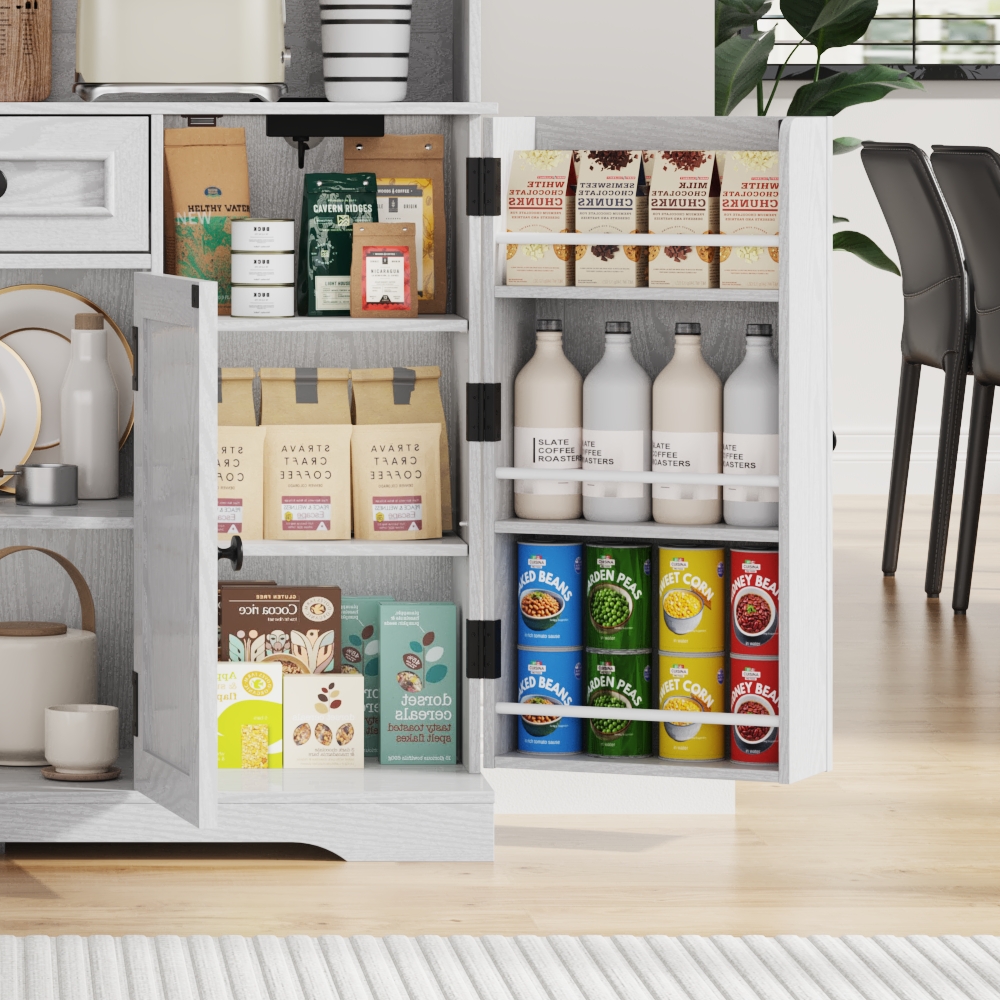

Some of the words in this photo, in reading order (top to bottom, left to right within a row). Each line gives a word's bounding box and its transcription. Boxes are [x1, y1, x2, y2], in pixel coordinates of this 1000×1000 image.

[177, 211, 211, 225] NEW
[313, 204, 344, 213] CAVERN
[345, 204, 372, 213] RIDGES
[538, 570, 572, 602] BEANS
[617, 573, 642, 600] PEAS
[683, 573, 714, 601] CORN
[538, 676, 572, 705] BEANS
[617, 678, 642, 706] PEAS
[683, 680, 714, 708] CORN
